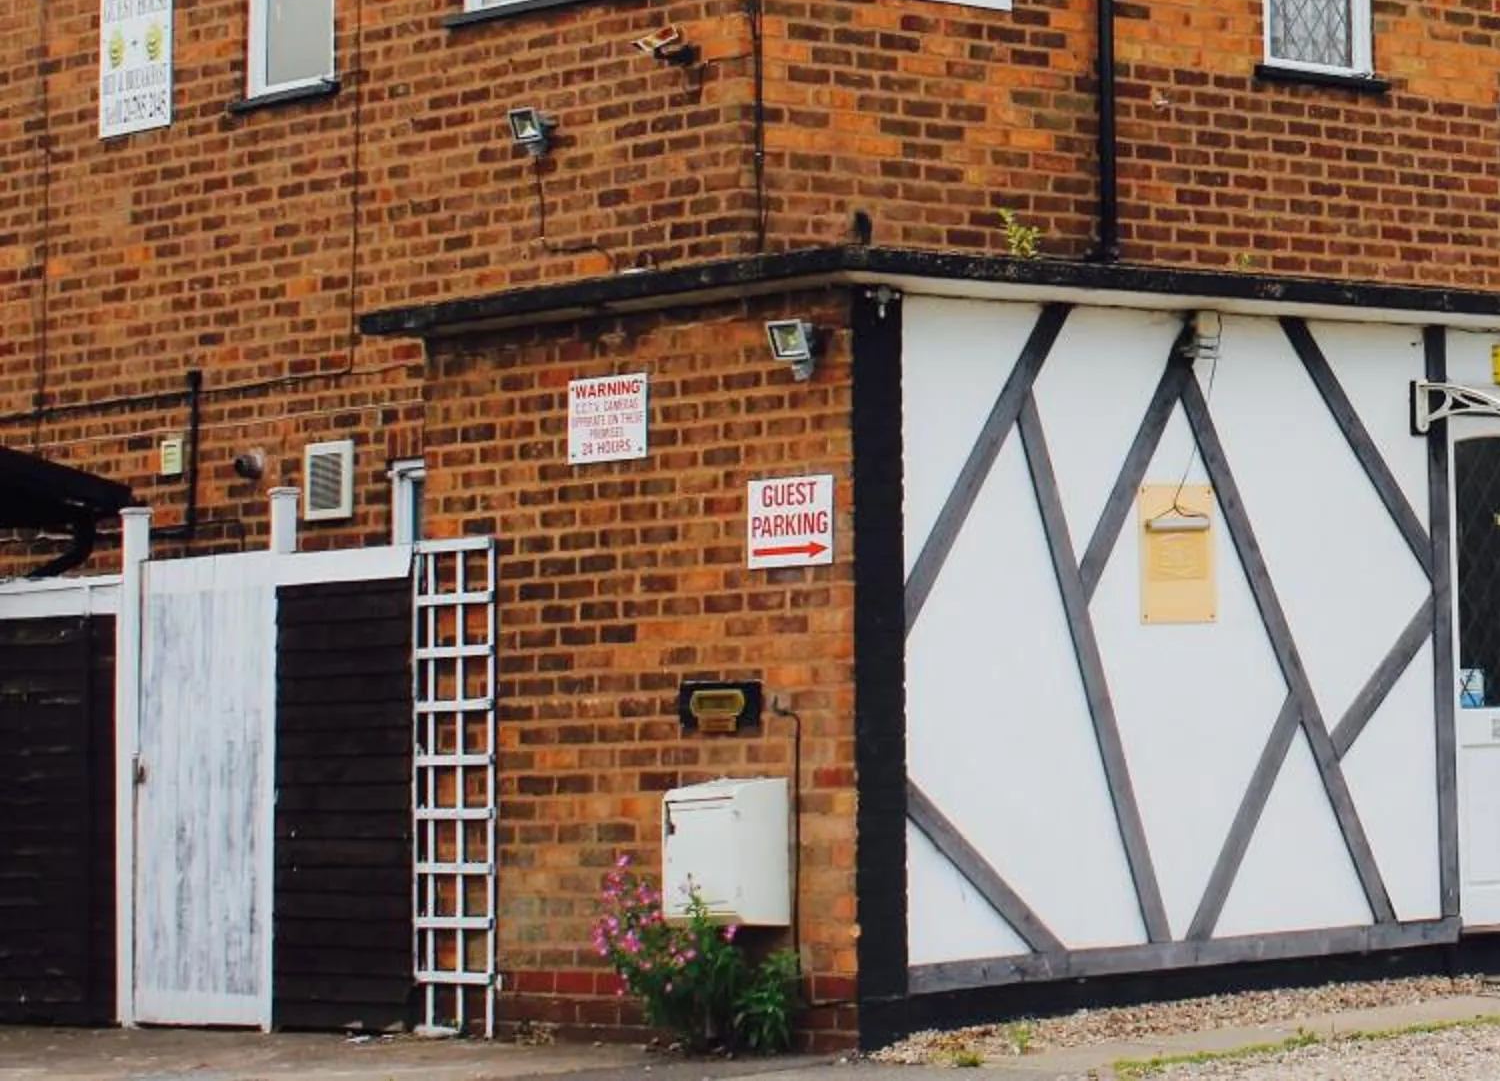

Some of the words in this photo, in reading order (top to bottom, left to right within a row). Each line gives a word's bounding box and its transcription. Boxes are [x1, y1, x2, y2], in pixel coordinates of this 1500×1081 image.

[576, 380, 641, 399] WARNING
[582, 442, 593, 456] 24
[598, 439, 632, 455] HOURS
[762, 481, 817, 508] GUEST
[752, 511, 829, 538] PARKING
